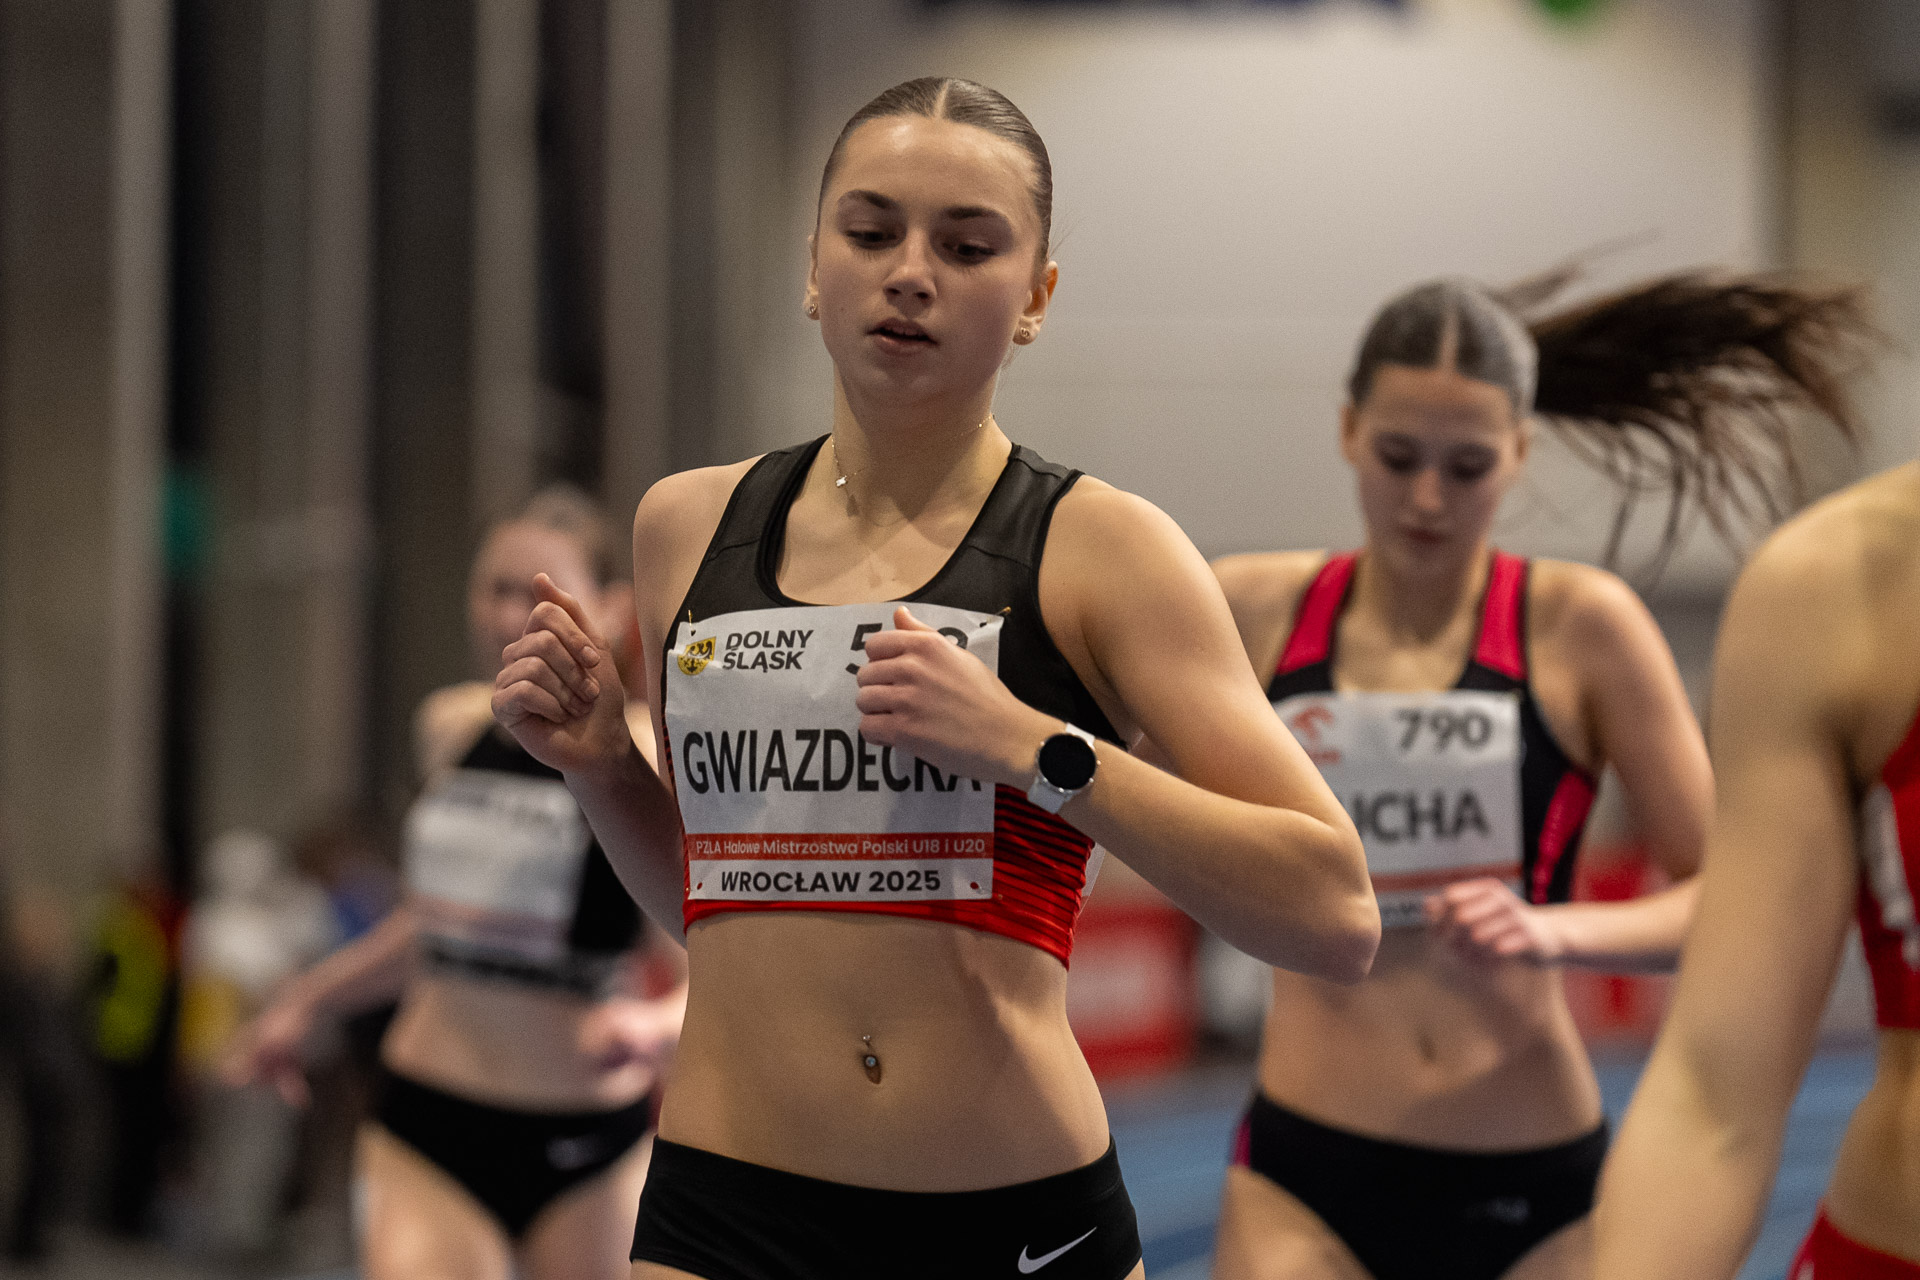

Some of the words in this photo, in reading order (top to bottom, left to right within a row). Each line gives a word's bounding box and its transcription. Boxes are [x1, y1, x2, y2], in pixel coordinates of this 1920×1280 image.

[724, 629, 814, 651] DOLNY
[722, 646, 804, 673] ŚLĄSK
[1397, 707, 1493, 752] 790
[683, 728, 982, 793] GWIAZDECK
[696, 840, 721, 854] PZLA
[723, 840, 760, 854] Halowe
[763, 839, 858, 855] Mistrzostwa
[862, 839, 908, 854] Polski
[912, 839, 940, 853] U18
[945, 838, 949, 853] i
[953, 838, 985, 853] U20
[721, 871, 861, 892] WROCŁAW
[868, 870, 941, 892] 2025
